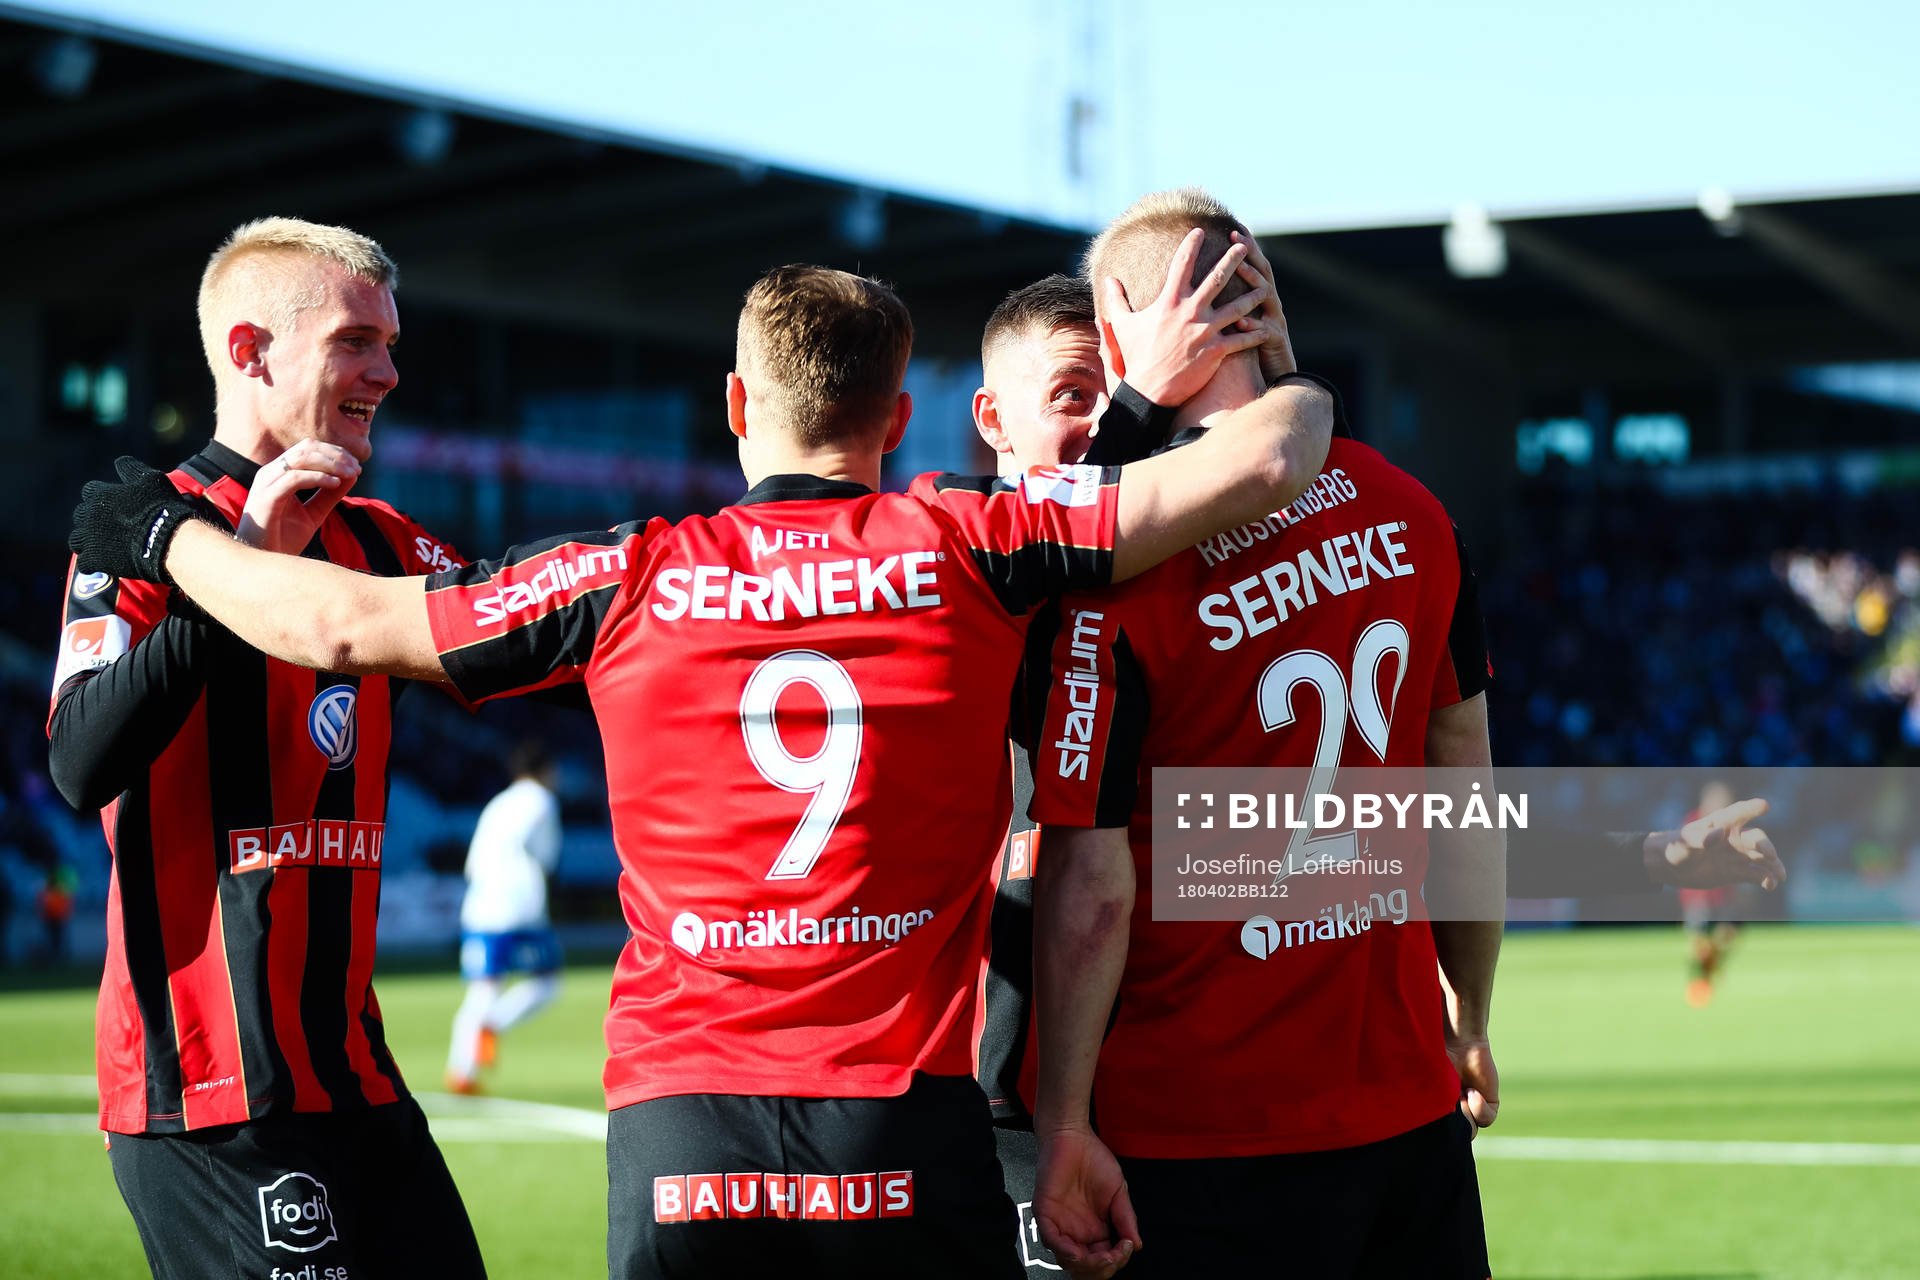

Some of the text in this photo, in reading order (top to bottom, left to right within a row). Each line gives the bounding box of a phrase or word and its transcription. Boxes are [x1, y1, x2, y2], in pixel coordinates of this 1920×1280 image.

[752, 525, 829, 561] AJETI
[473, 547, 628, 627] stadium
[651, 551, 941, 621] SERNEKE
[1198, 521, 1415, 651] SERNEKE
[1055, 609, 1104, 781] stadium
[739, 650, 863, 880] 9
[195, 1076, 235, 1091] DRI-FIT
[270, 1196, 325, 1224] fodi
[659, 1179, 910, 1215] BAUHAUS
